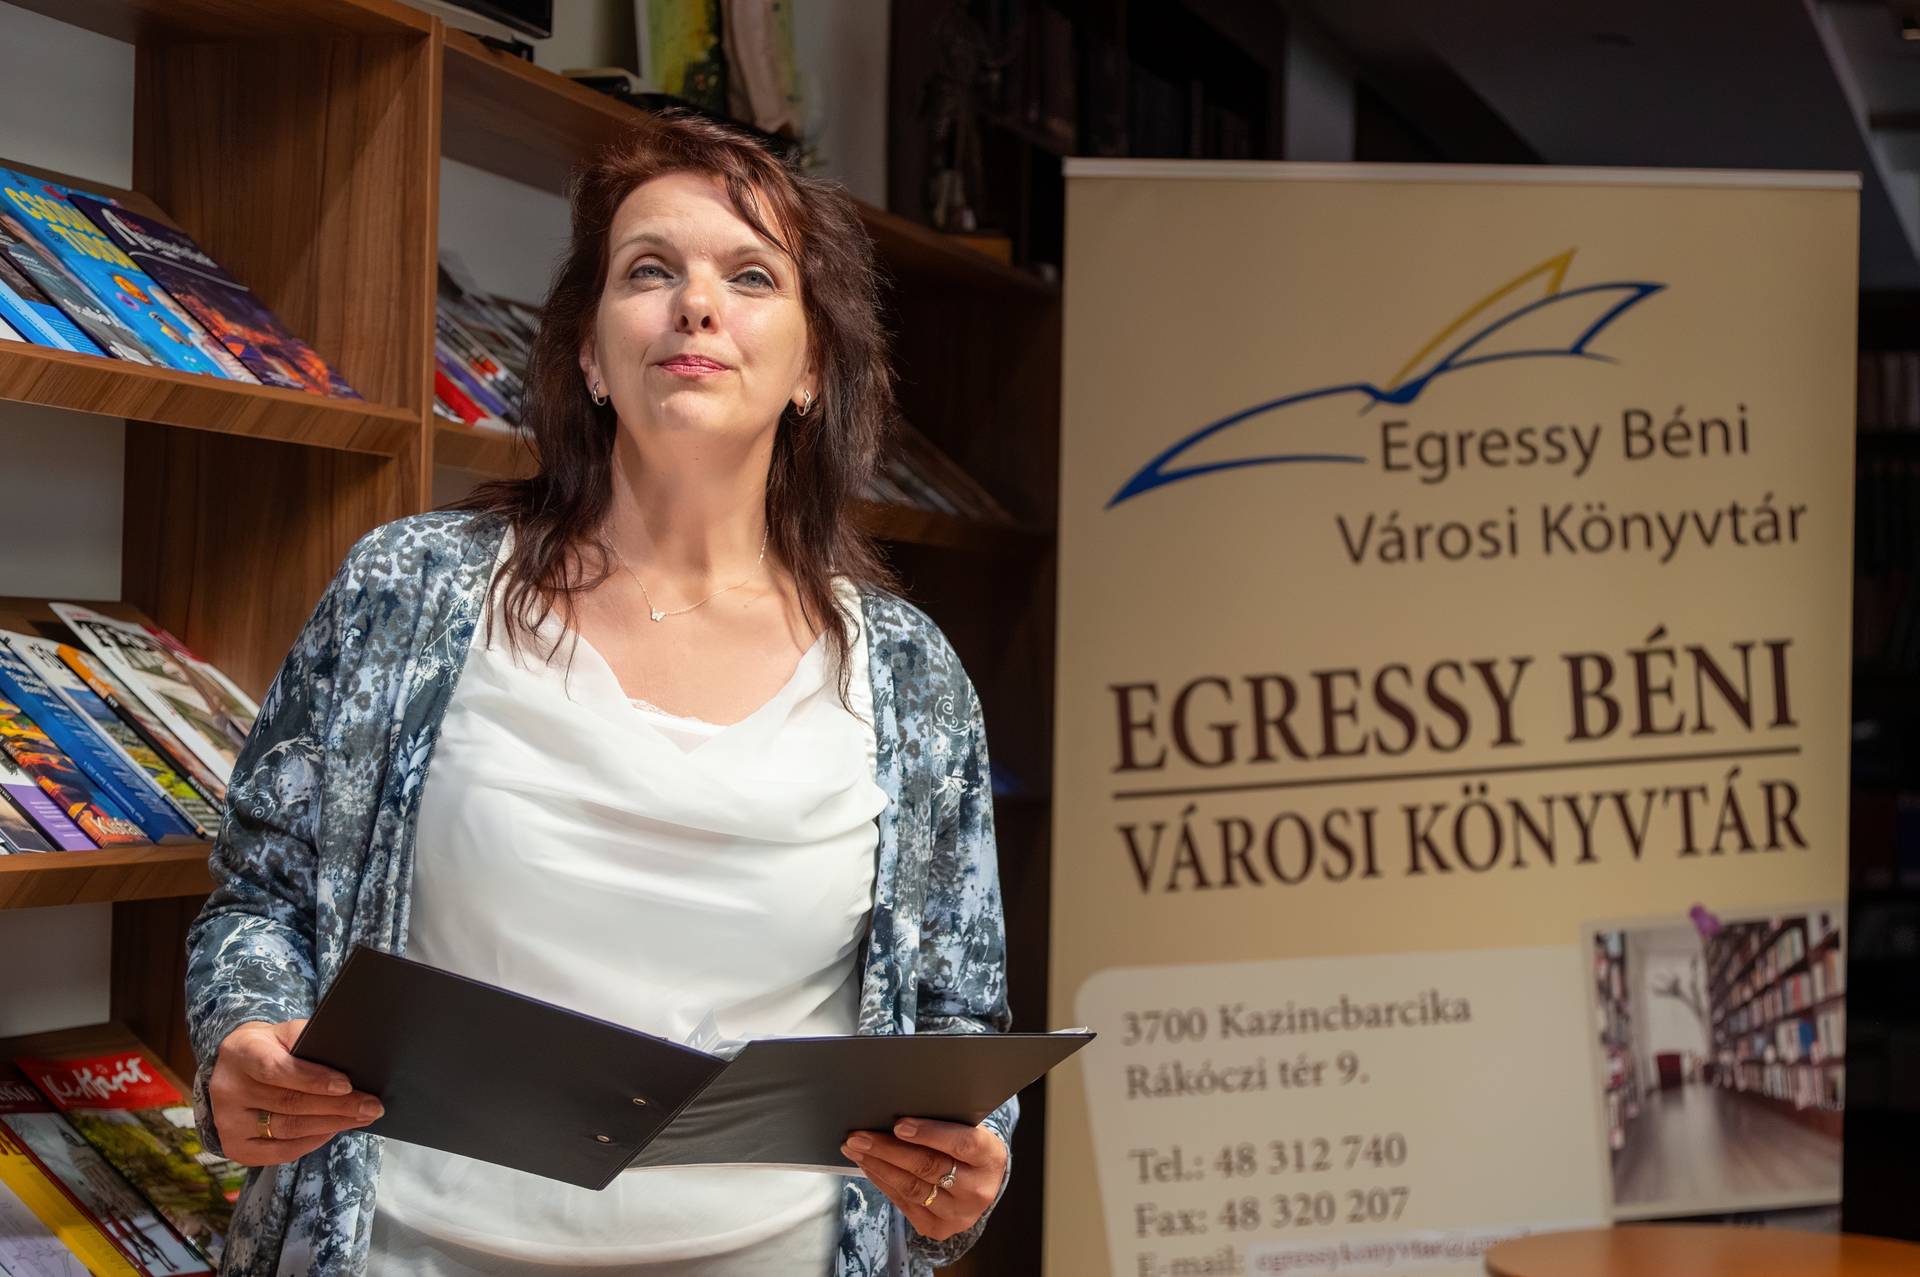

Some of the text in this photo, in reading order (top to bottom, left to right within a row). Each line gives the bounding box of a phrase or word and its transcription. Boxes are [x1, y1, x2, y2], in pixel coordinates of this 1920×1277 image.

[1379, 403, 1750, 486] Egressy Béni
[1334, 490, 1810, 567] Városi Könyvtár
[1107, 624, 1800, 775] EGRESSY BÉNI
[1115, 764, 1810, 896] VÁROSI KÖNYVTÁR
[1121, 988, 1473, 1046] 3700 Kazincbarcika
[1124, 1051, 1370, 1101] Rákóczi tér 9.
[1127, 1131, 1408, 1185] Tel.: 48 312 740
[1133, 1184, 1411, 1239] Fax: 48 320 207
